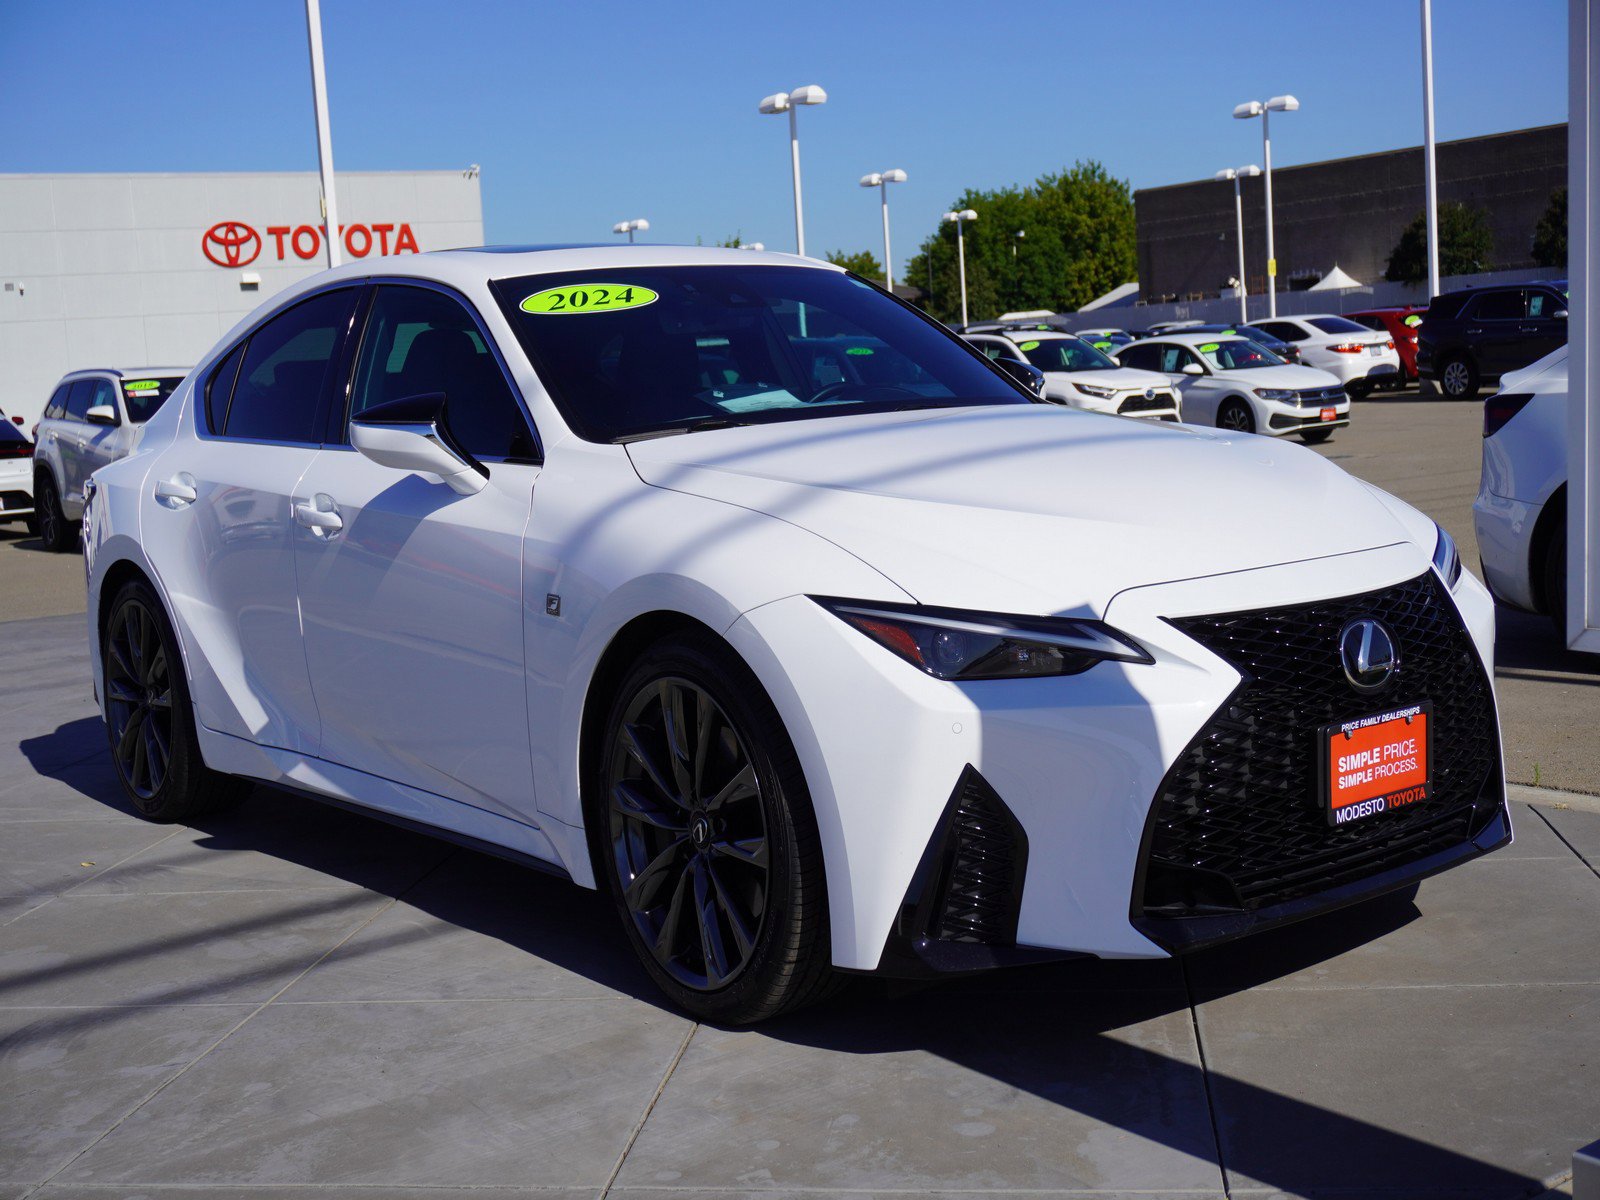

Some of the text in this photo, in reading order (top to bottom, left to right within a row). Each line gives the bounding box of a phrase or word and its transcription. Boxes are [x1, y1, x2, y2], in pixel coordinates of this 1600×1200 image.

[547, 287, 635, 311] 2024
[1341, 706, 1420, 732] PRICE FAMILY DEALERSHIPS
[1338, 738, 1418, 773] SIMPLE PRICE.
[1338, 757, 1418, 789] SIMPLE PROCESS.
[1336, 787, 1427, 824] MODESTO TOYOTA
